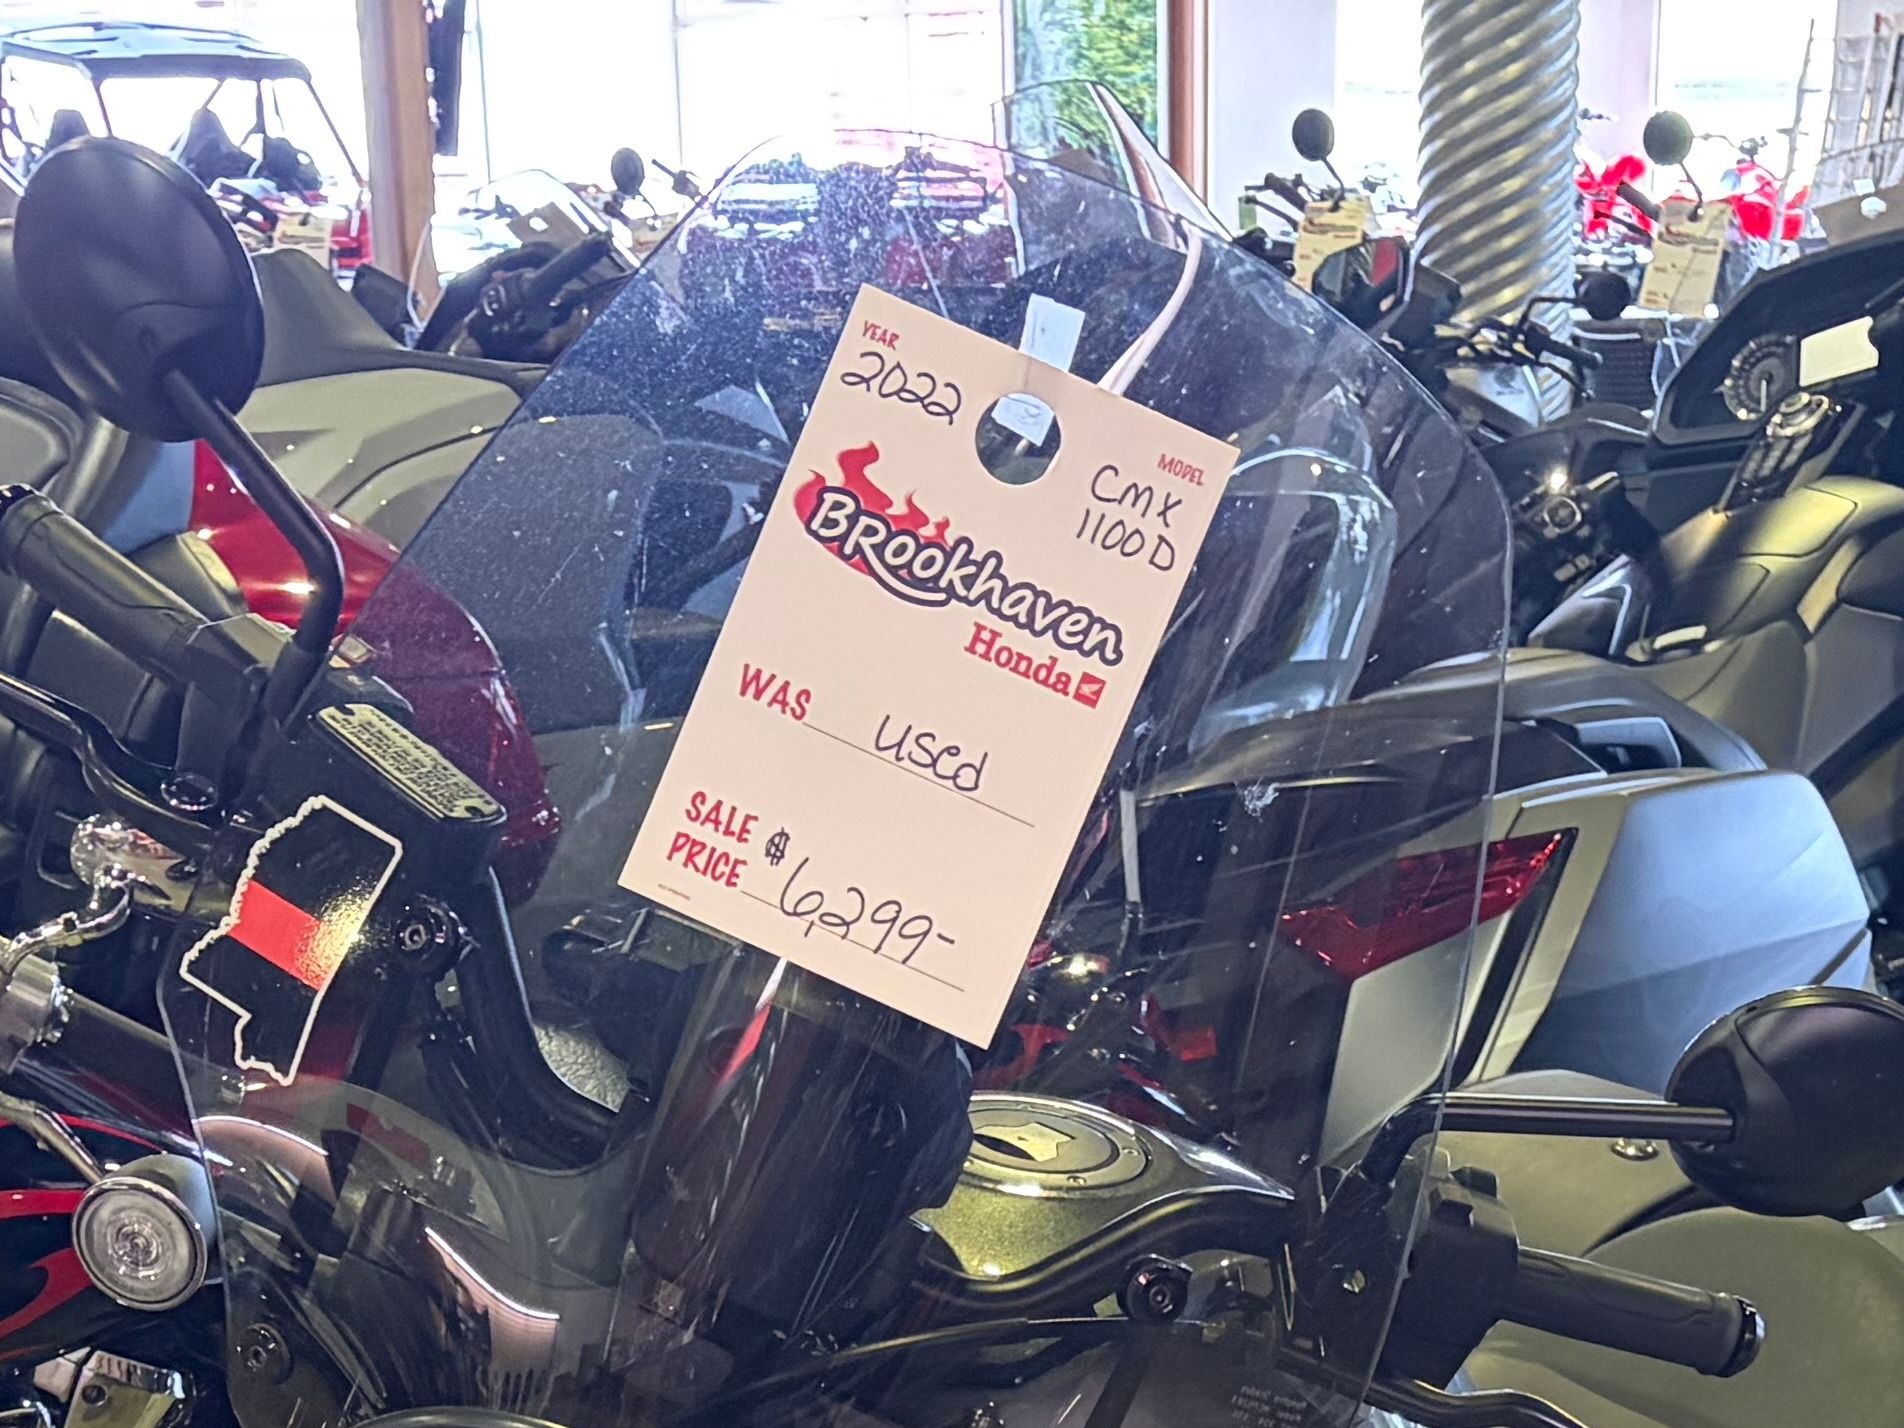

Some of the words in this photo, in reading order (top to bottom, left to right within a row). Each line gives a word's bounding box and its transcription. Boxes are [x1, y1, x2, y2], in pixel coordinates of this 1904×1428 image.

[862, 320, 900, 351] YEAR
[840, 351, 962, 426] 2022
[1091, 464, 1183, 528] CMX
[1157, 453, 1204, 486] MODEL
[964, 621, 1072, 697] Honda
[739, 663, 812, 721] WAS
[685, 791, 759, 843] SALE
[666, 831, 748, 888] PRICE
